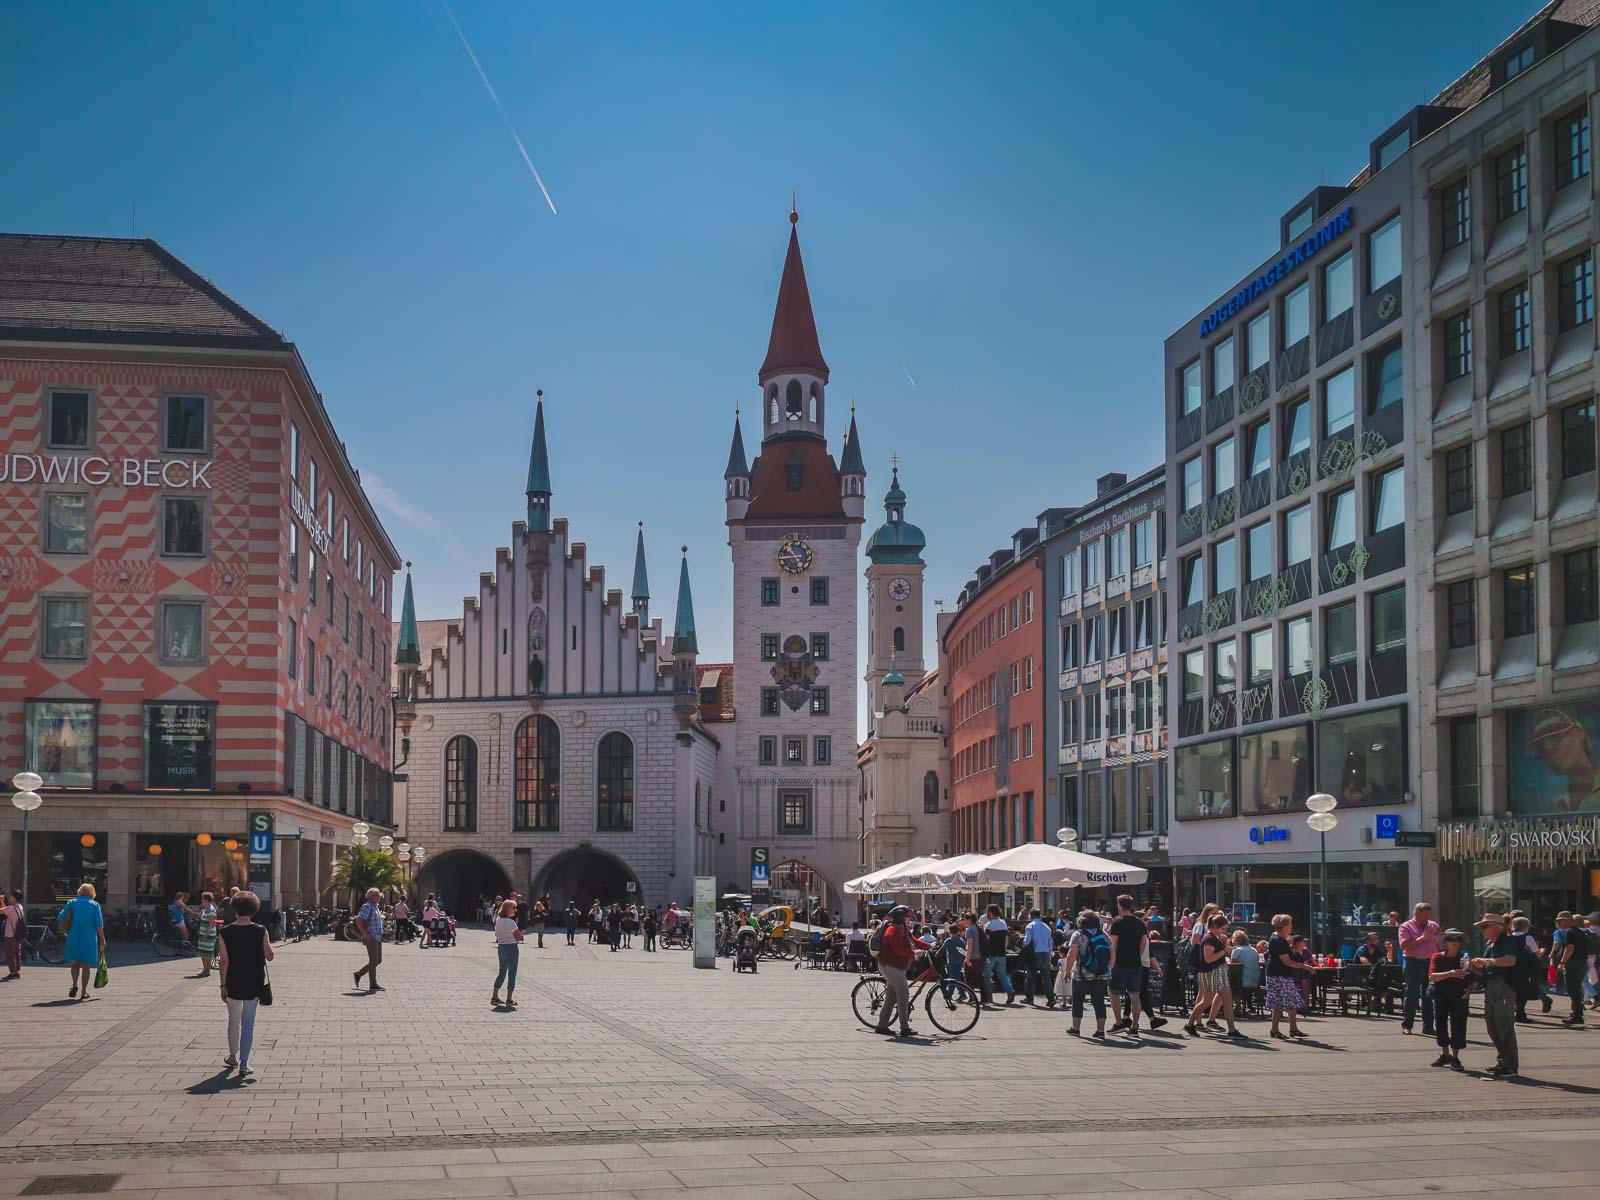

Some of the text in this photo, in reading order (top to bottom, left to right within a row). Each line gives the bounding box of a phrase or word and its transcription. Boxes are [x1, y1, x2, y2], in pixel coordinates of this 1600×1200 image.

[1199, 206, 1354, 339] AUGENTAGESKLINIK
[123, 458, 213, 489] BECK
[315, 520, 329, 560] BECK
[167, 767, 197, 775] MUSIK
[255, 815, 268, 831] S
[1263, 825, 1288, 842] Live
[1510, 829, 1596, 848] SWAROVSKI
[254, 835, 267, 852] U
[755, 848, 766, 862] S
[754, 865, 765, 879] U
[1014, 871, 1127, 883] Café Rischart
